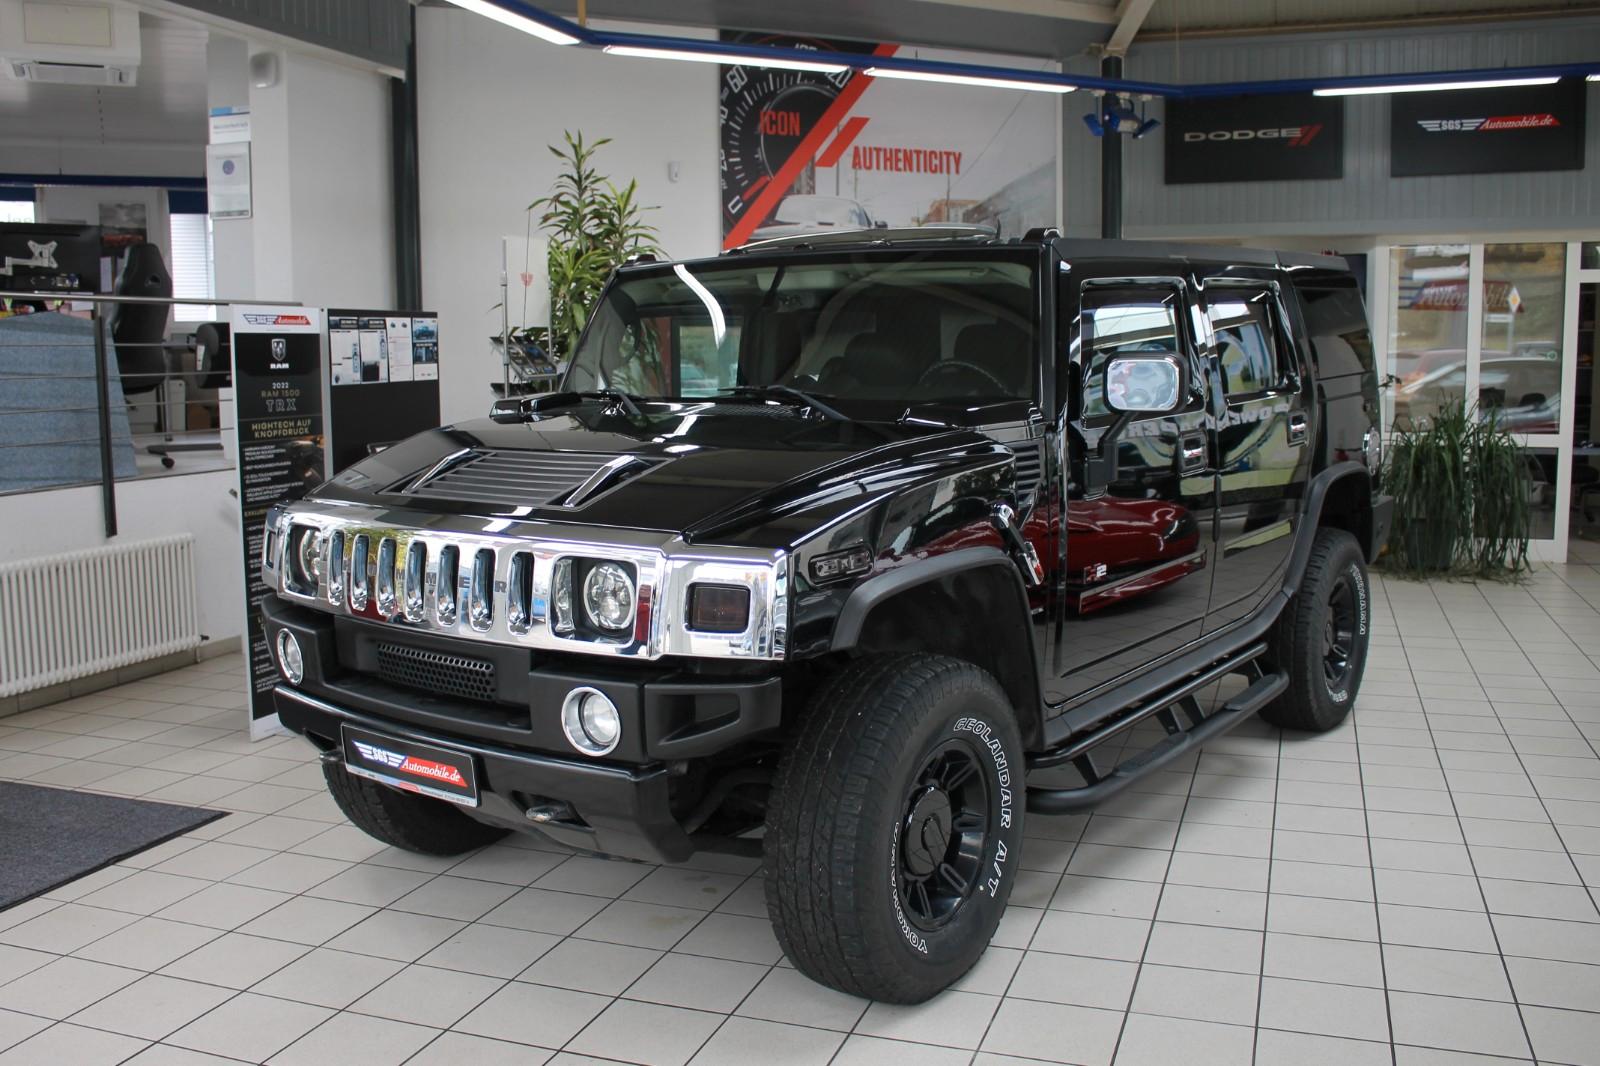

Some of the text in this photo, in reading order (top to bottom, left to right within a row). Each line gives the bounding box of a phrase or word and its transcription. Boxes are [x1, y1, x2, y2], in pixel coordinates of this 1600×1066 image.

[726, 65, 748, 93] 60
[760, 110, 800, 136] ICON
[1440, 114, 1553, 130] SGS Automobile.de
[1184, 128, 1303, 142] DODGE
[852, 145, 962, 175] AUTHENTICITY
[261, 389, 300, 398] RAM 1500
[266, 398, 296, 412] TRX
[251, 418, 312, 431] HIGHTECH AUF
[254, 427, 309, 439] KNOPFDRUCK
[372, 747, 460, 782] SGS Automobile.de
[953, 717, 1012, 897] GEOLANDAR A/T
